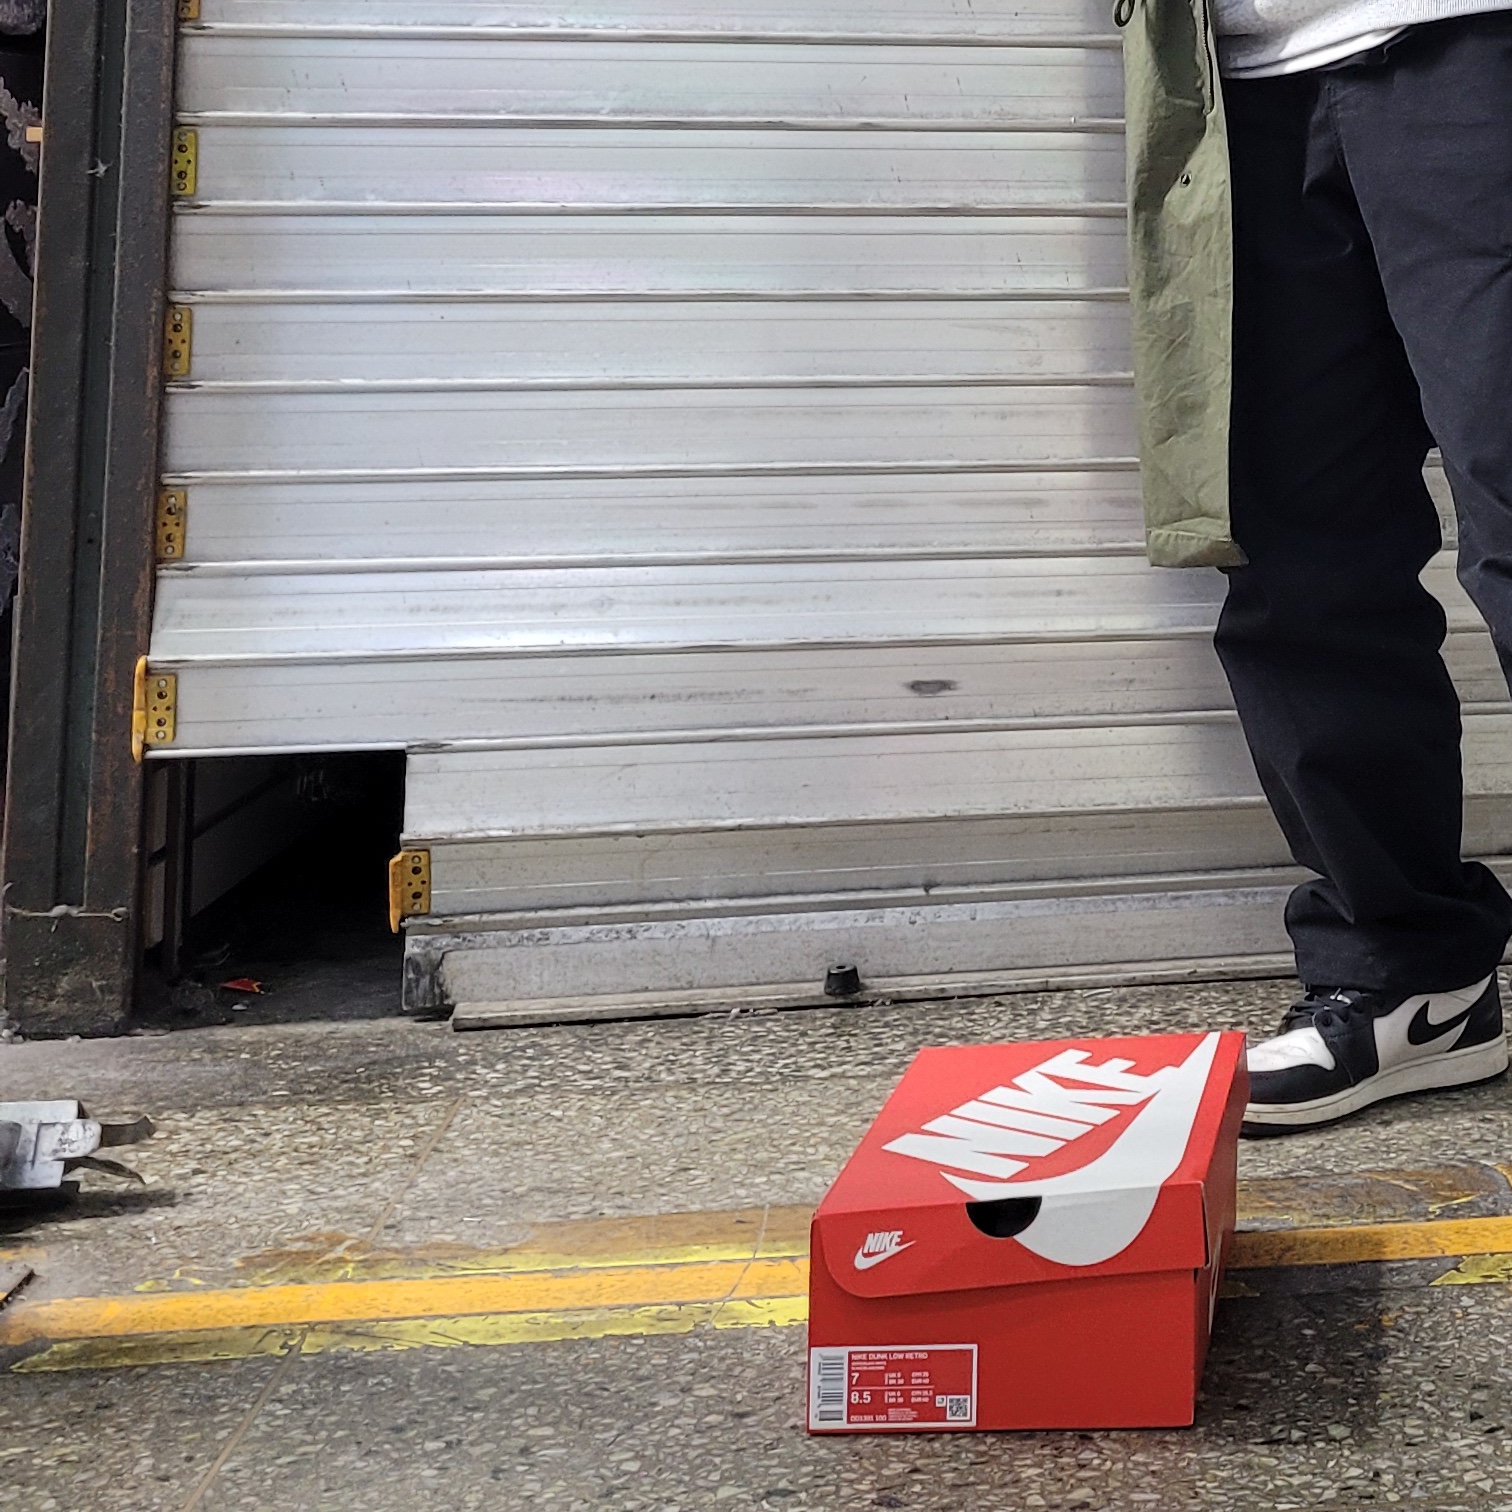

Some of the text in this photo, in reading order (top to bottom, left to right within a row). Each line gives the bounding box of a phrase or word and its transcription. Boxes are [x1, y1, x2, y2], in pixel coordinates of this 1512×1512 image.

[881, 1048, 1180, 1180] NIKE
[862, 1230, 903, 1254] NIKE
[851, 1372, 860, 1385] 7
[850, 1391, 871, 1404] 8.5
